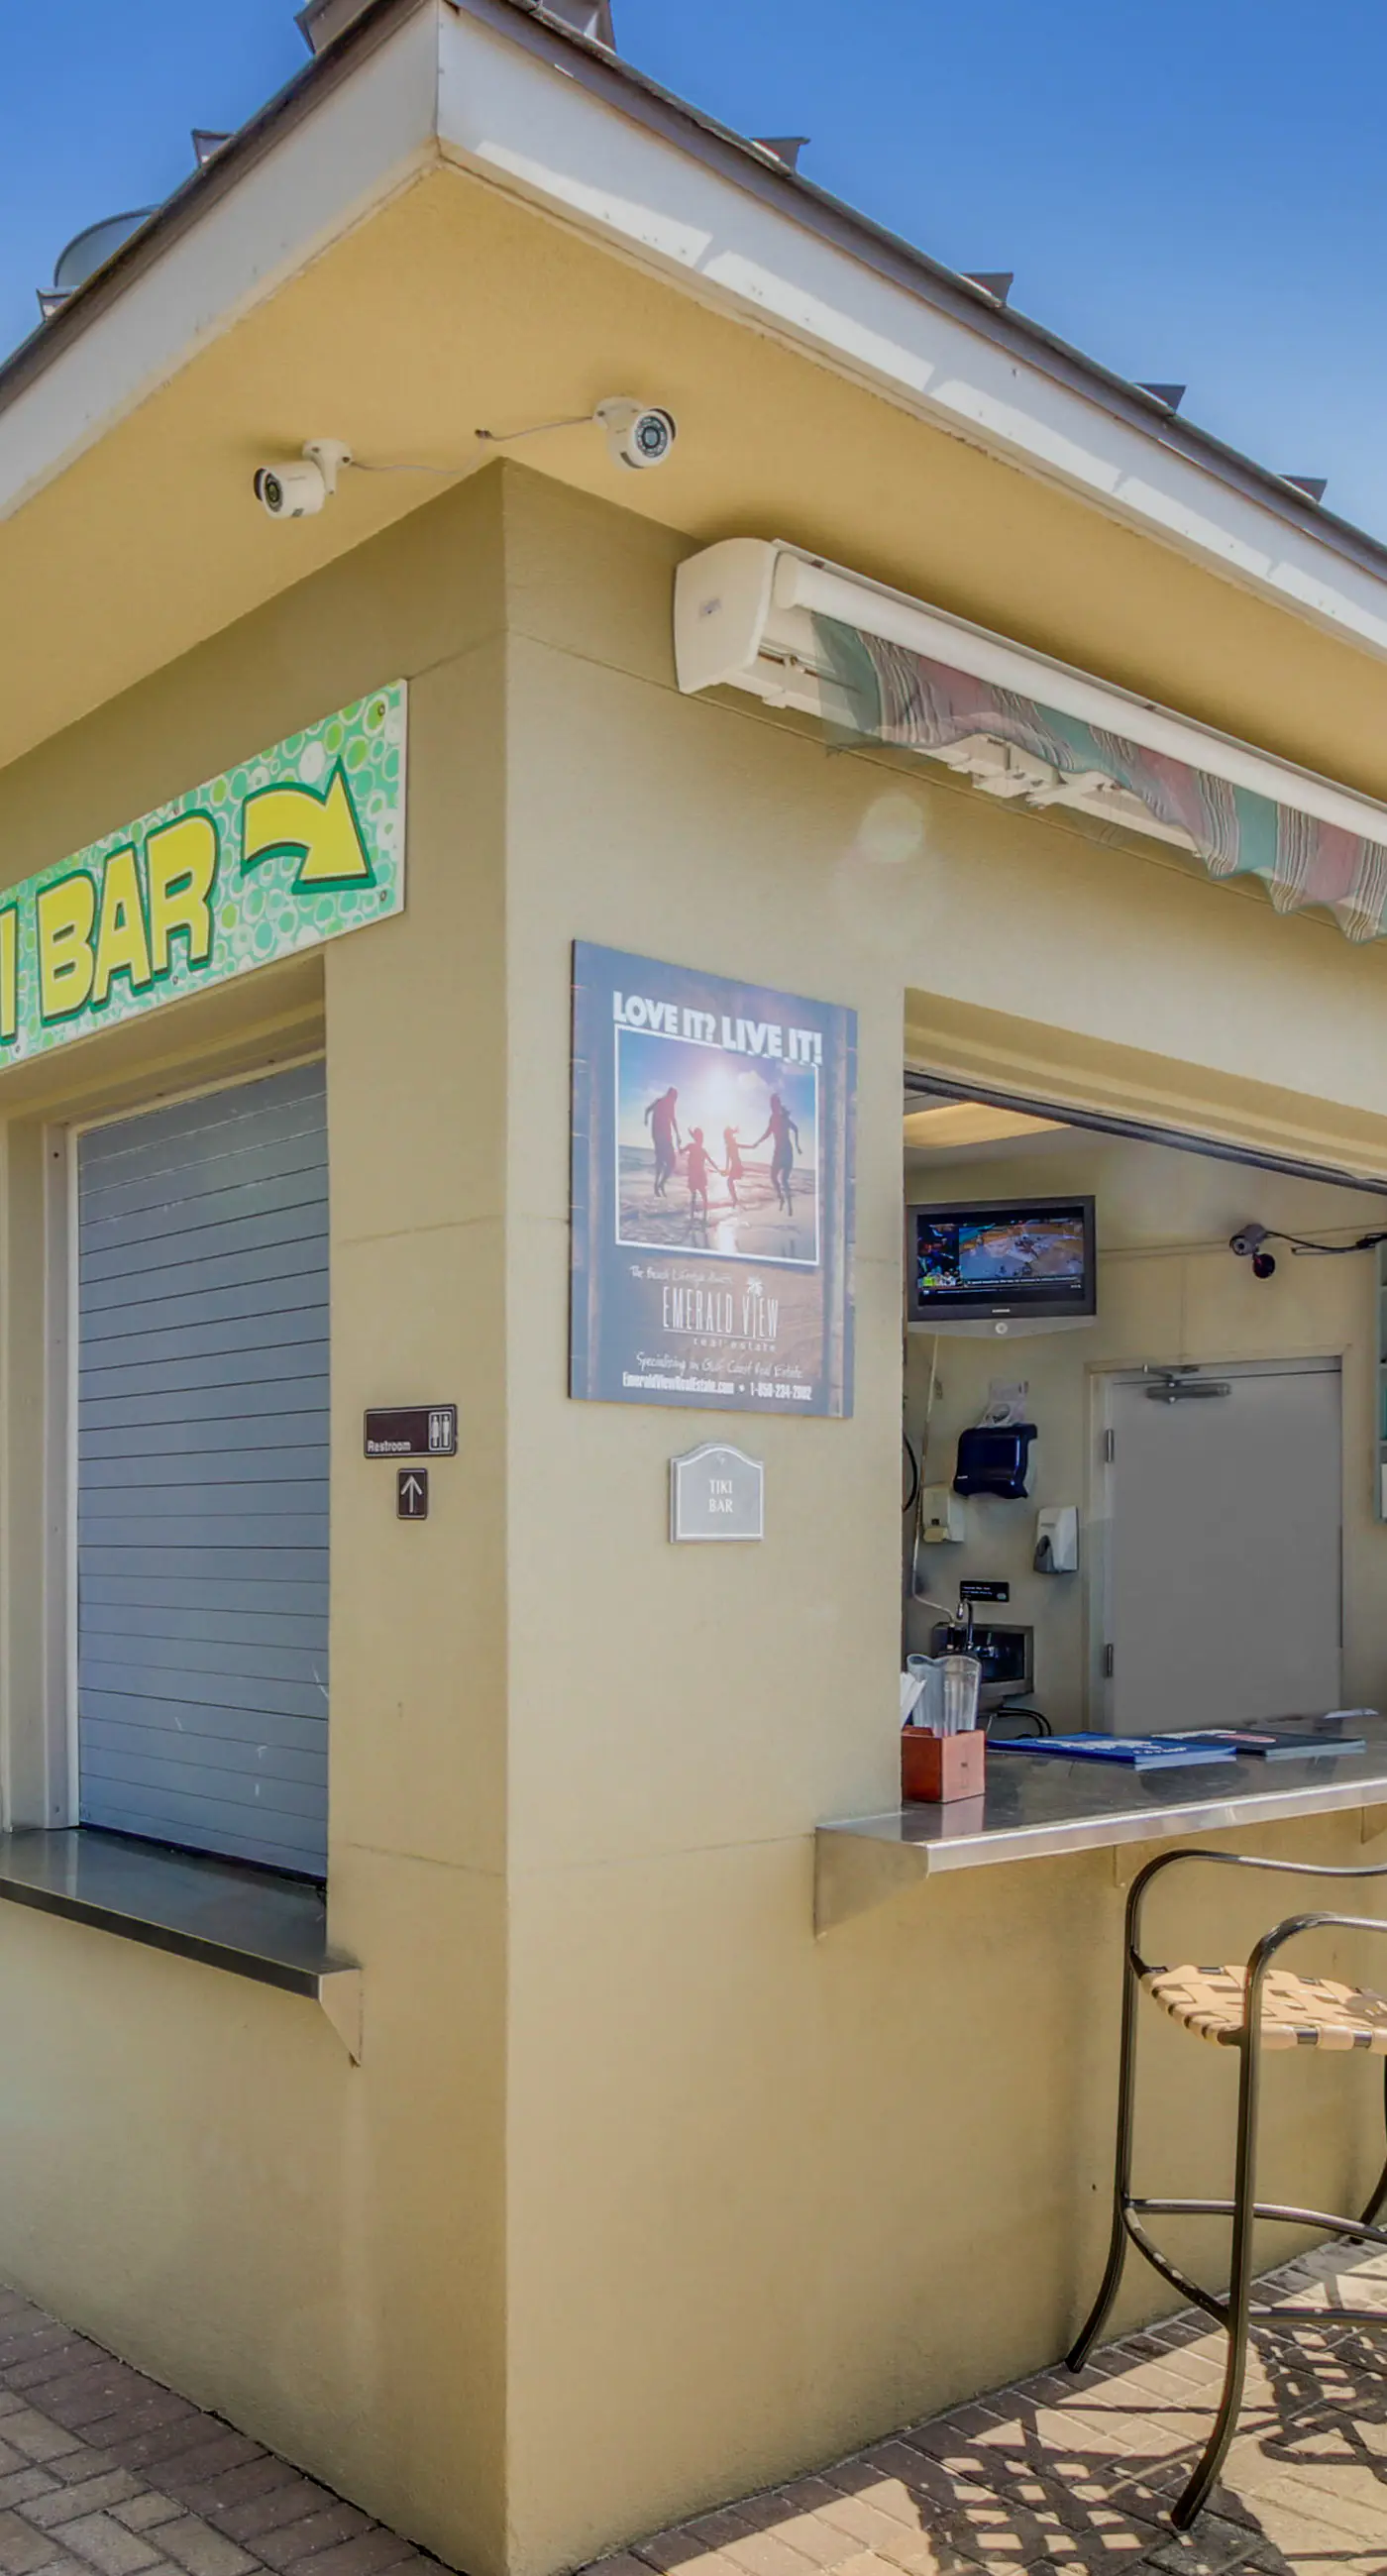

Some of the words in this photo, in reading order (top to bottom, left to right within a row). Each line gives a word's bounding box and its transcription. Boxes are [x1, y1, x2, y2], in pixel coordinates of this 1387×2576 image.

[36, 808, 220, 1026] BAR
[612, 991, 679, 1035] LOVE
[683, 1008, 716, 1041] IT?
[721, 1016, 783, 1058] LIVE
[788, 1027, 823, 1065] IT!
[662, 1285, 733, 1334] EMERALD
[742, 1292, 779, 1340] VIEW
[367, 1440, 412, 1452] Restroom
[708, 1479, 733, 1495] TIKI
[708, 1498, 734, 1513] BAR
